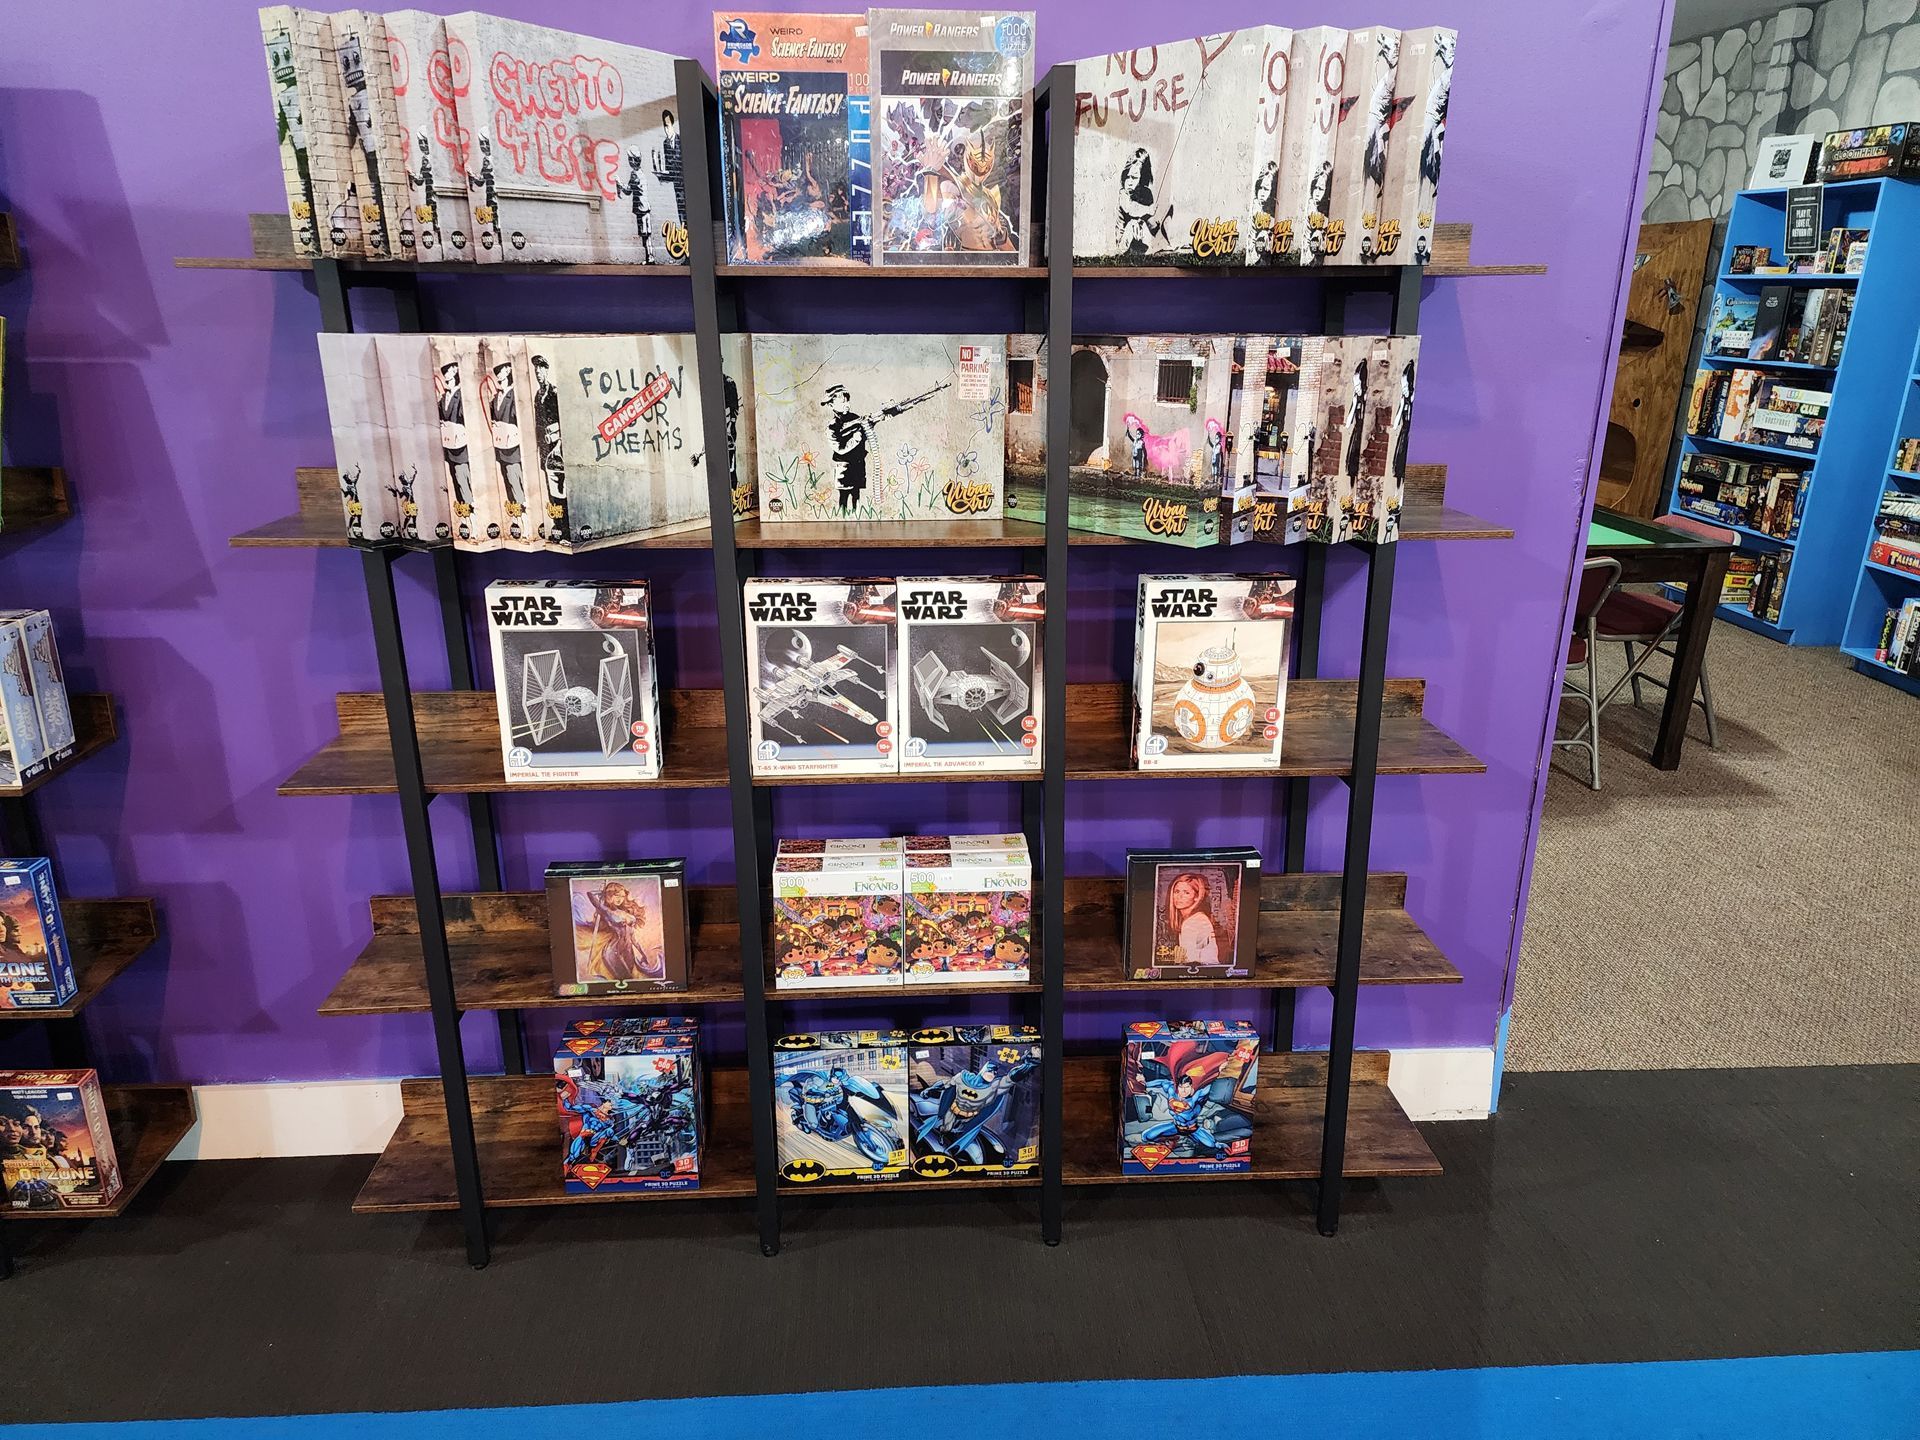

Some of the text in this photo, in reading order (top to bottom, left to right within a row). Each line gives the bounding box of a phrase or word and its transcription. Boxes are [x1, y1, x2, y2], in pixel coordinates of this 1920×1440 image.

[890, 22, 980, 37] POWER RANGERS
[731, 72, 780, 83] WEIRD
[902, 70, 1002, 86] POWER RANGERS
[490, 51, 623, 122] GHETTO
[1074, 73, 1188, 136] FUTURE
[494, 109, 529, 174] 4
[1796, 210, 1806, 218] PLAY
[1796, 219, 1806, 227] LOVE
[662, 220, 688, 248] Urb
[1190, 216, 1238, 246] Urban
[1792, 229, 1806, 237] RETURN
[1196, 231, 1240, 258] Art
[961, 348, 972, 360] NO
[961, 363, 989, 374] PARKING
[604, 377, 669, 437] CANCELLED
[1800, 403, 1820, 416] CLUE
[592, 427, 682, 462] DREAMS
[942, 479, 992, 502] Urban
[951, 494, 994, 514] Art
[1142, 497, 1188, 523] Urban
[1150, 514, 1189, 536] Art
[1890, 551, 1920, 568] TALISM
[749, 593, 816, 606] STAR
[902, 591, 967, 605] STAR
[1152, 589, 1217, 602] STAR
[491, 596, 562, 610] STAR
[749, 608, 816, 621] WARS
[902, 606, 967, 619] WARS
[1152, 604, 1217, 617] WARS
[492, 612, 562, 626] WARS
[779, 876, 804, 888] 500
[910, 872, 935, 883] 500
[984, 878, 1028, 888] ENCANTO
[855, 882, 898, 892] ENCANTO
[0, 962, 47, 976] ZONE
[5, 1167, 96, 1180] HOT ZONE
